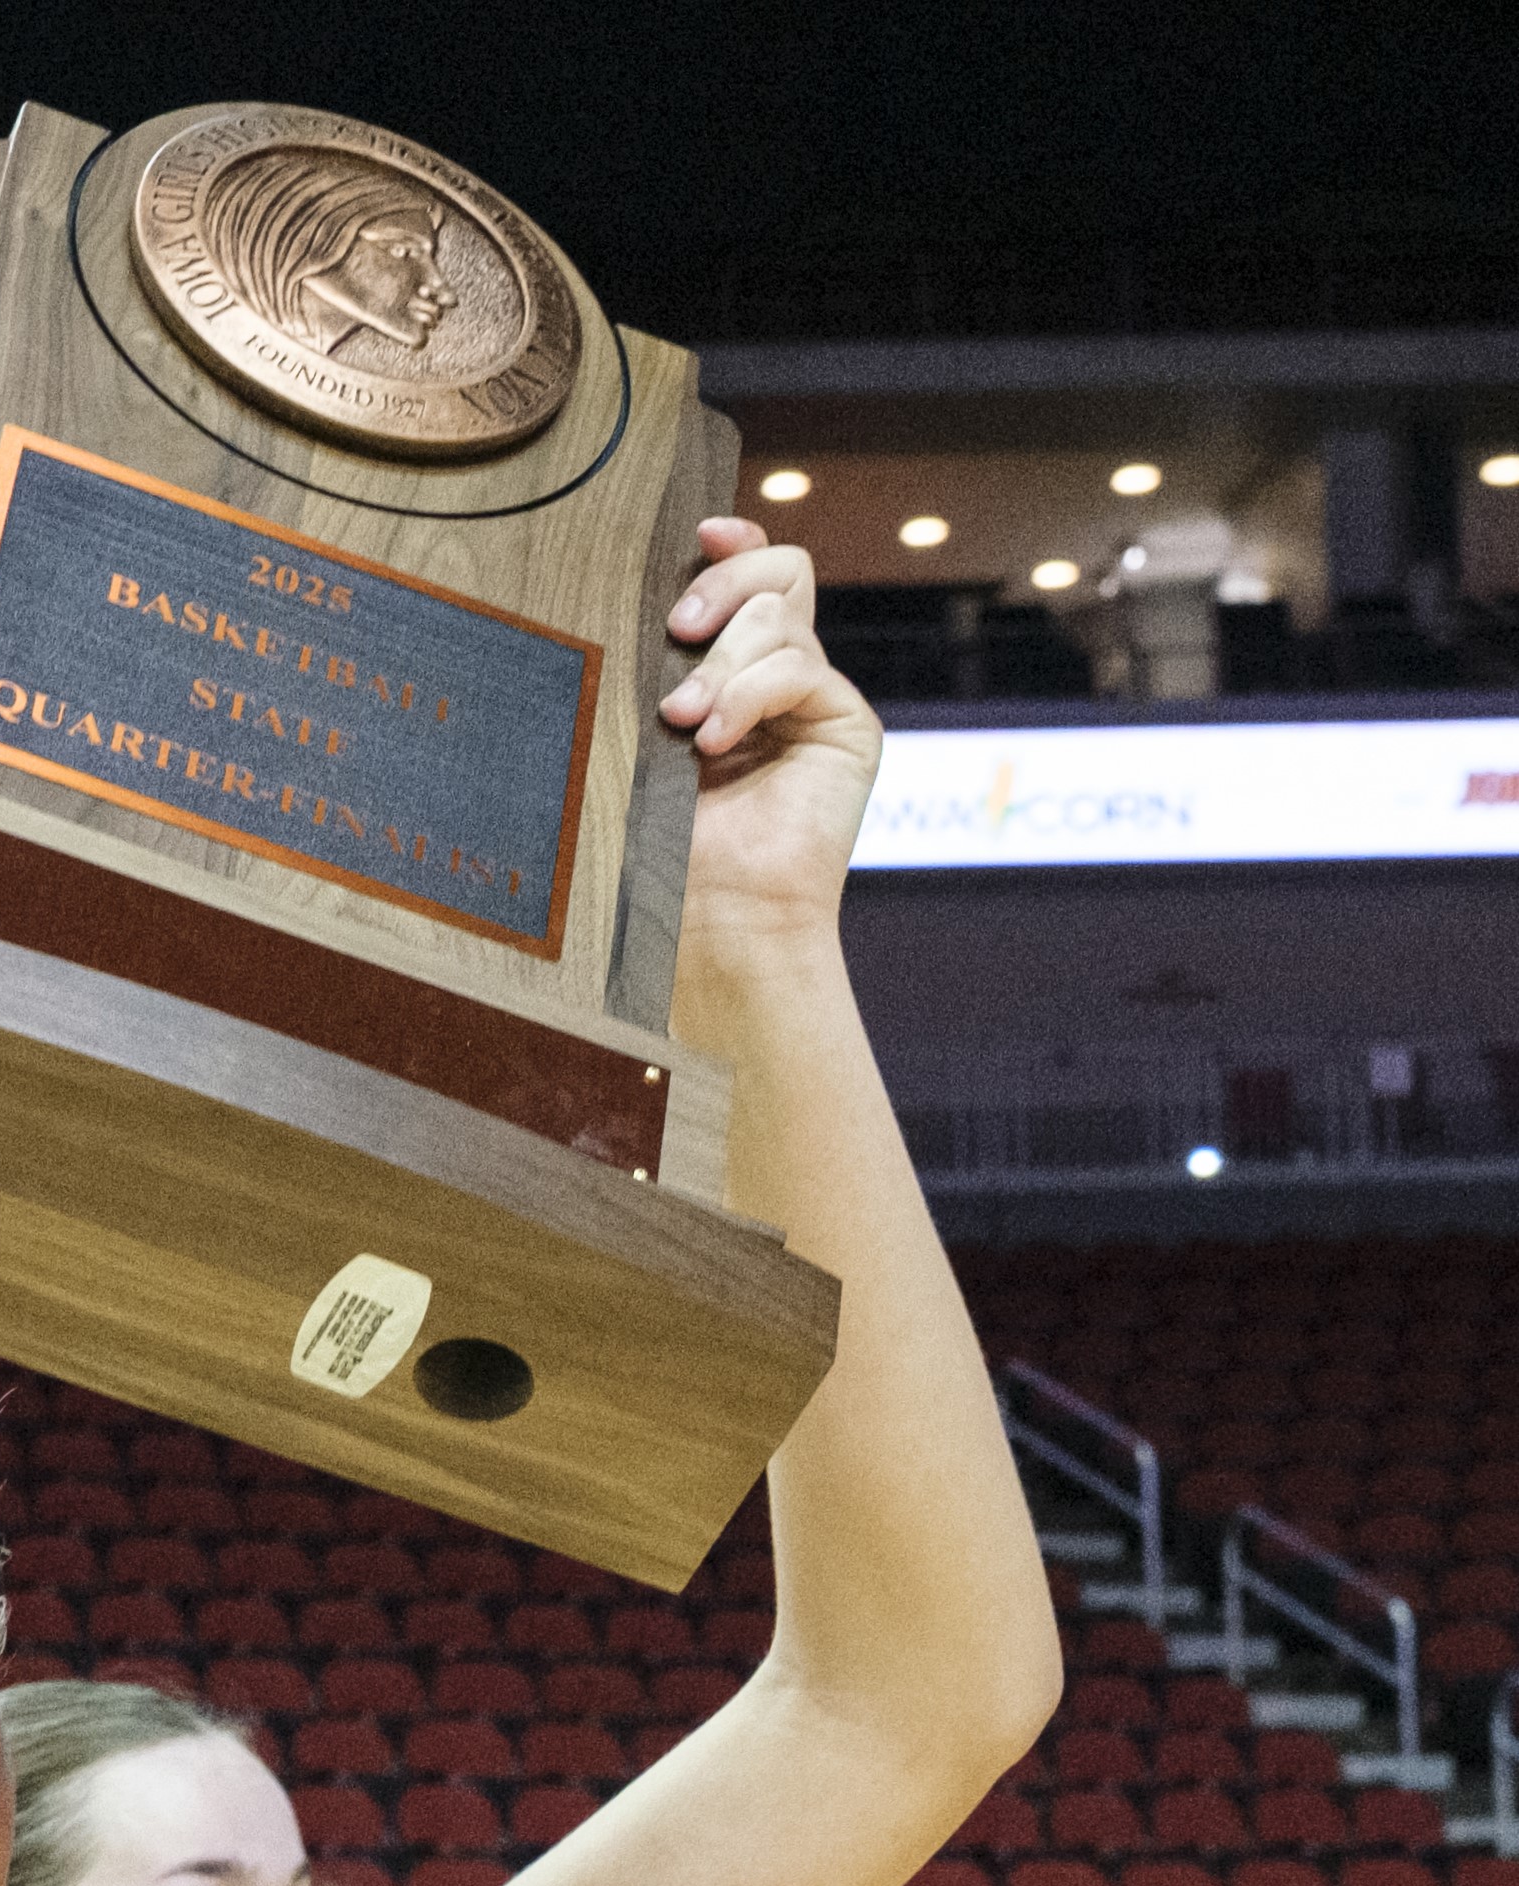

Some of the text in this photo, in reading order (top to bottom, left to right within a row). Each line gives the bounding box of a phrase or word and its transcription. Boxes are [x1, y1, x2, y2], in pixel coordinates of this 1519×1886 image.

[162, 232, 240, 321] IOWA
[244, 334, 375, 409] FOUNDED
[247, 554, 354, 614] 2025
[106, 572, 453, 723] BASKETBALL
[189, 676, 350, 756] STATE
